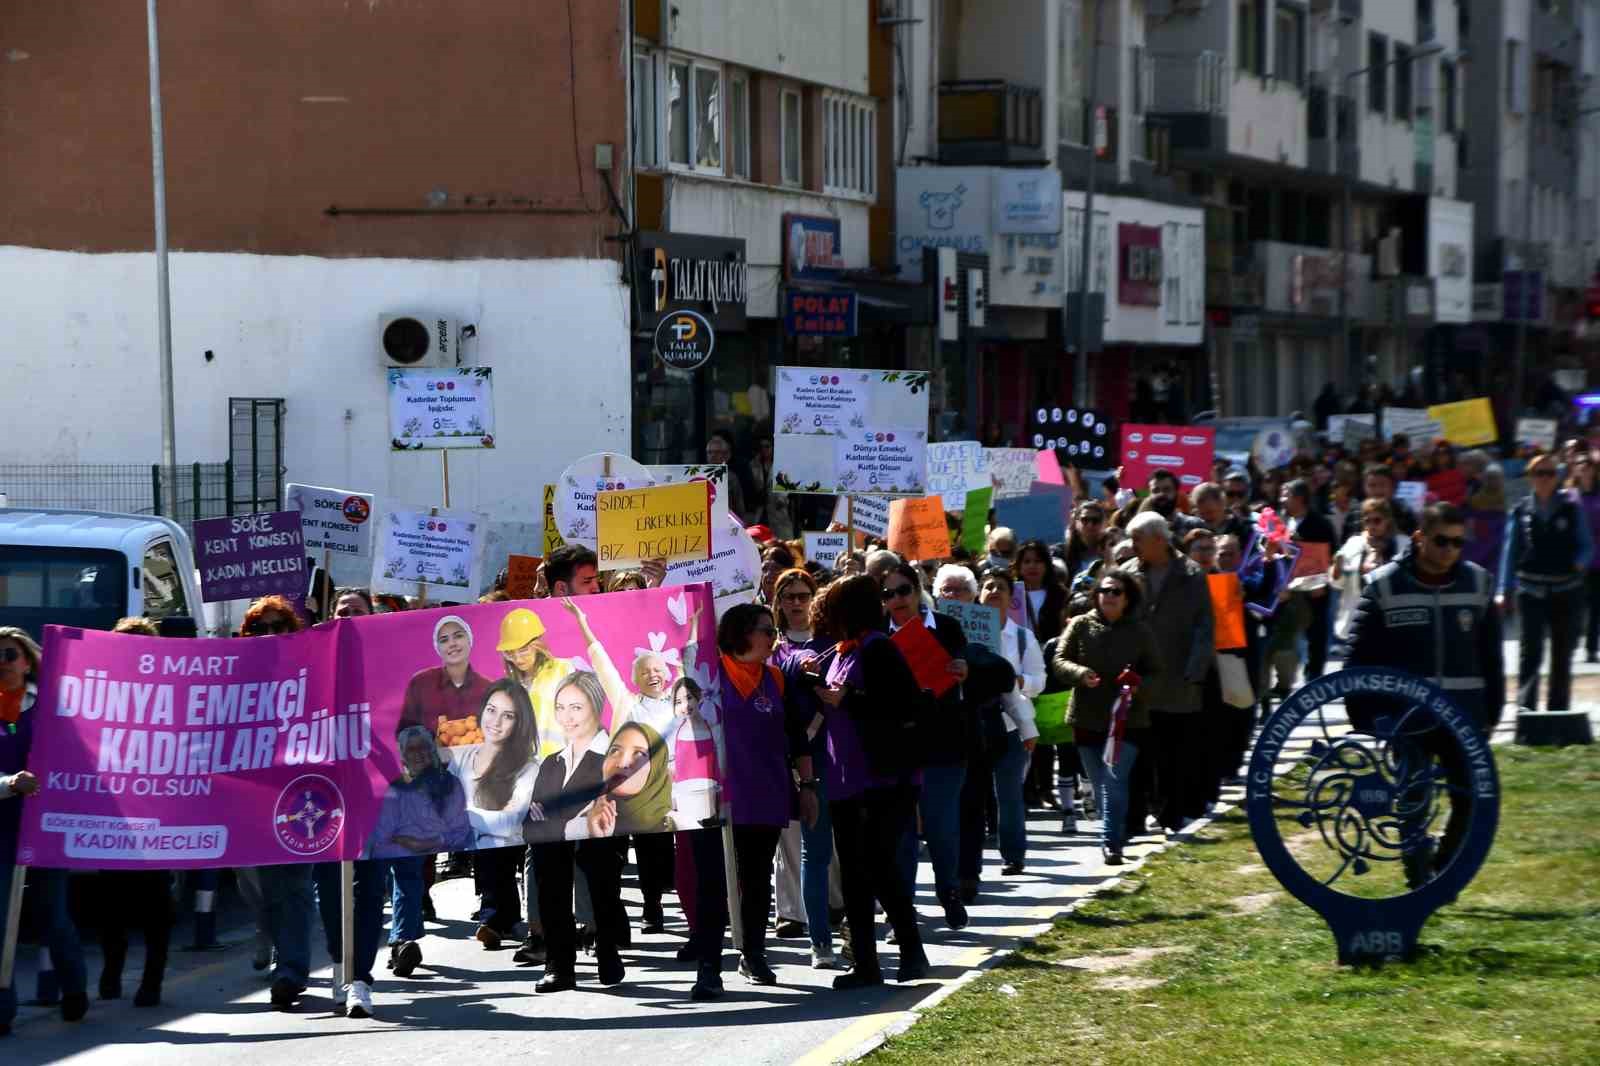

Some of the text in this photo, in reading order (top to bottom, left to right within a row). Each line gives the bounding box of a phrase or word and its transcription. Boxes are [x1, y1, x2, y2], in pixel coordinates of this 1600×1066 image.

[671, 258, 706, 301] TALAT
[792, 294, 849, 313] POLAT
[670, 342, 698, 351] TALAT
[846, 453, 877, 461] Kadınlar
[853, 443, 906, 453] Dünya Emekçi
[858, 463, 901, 471] Kutlu Olsun
[314, 497, 343, 511] SÖKE
[302, 518, 319, 528] ENT
[305, 539, 322, 549] DIN
[323, 531, 331, 539] &
[204, 537, 239, 555] KENT
[206, 560, 246, 583] KADIN
[138, 653, 240, 677] 8 MART
[56, 667, 308, 732] DÜNYA EMEKÇİ
[97, 702, 373, 776] KADINLAR GÜNÜ
[1264, 707, 1300, 763] AYDIN
[47, 771, 212, 797] KUTLU OLSUN
[74, 831, 219, 851] KADIN MECLİSİ
